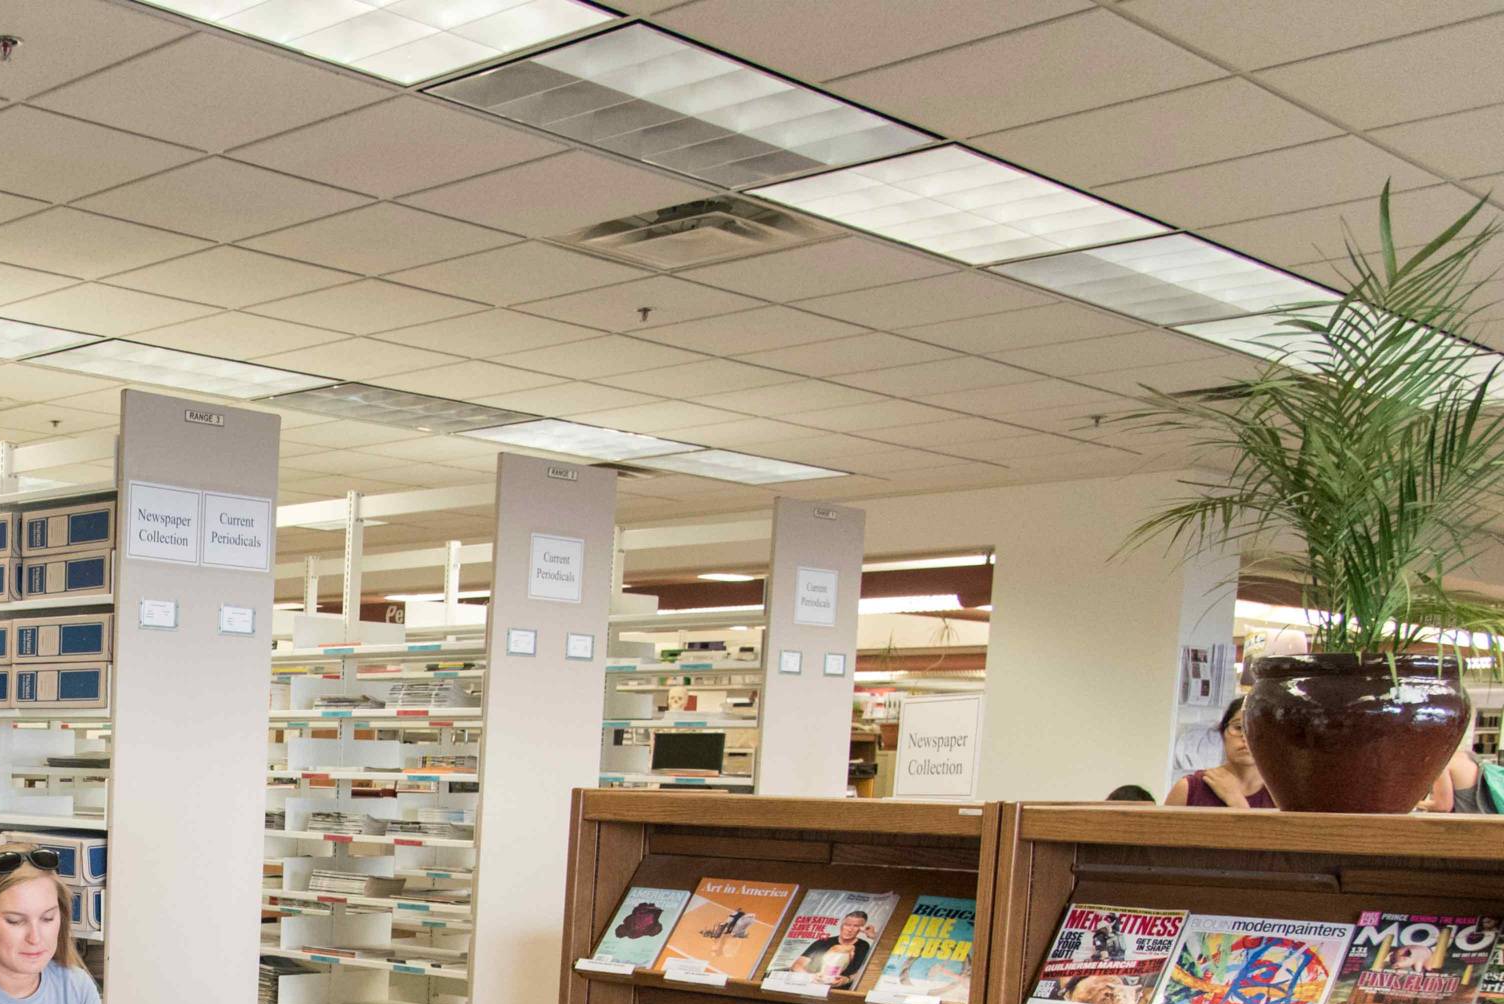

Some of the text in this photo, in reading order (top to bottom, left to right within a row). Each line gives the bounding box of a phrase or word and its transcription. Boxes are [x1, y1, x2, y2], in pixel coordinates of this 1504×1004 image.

[189, 410, 214, 423] RANGE
[137, 508, 192, 528] Newspaper
[219, 512, 255, 528] Current
[138, 528, 189, 547] Collection
[211, 531, 262, 548] Periodicals
[543, 551, 571, 565] Current
[536, 567, 575, 583] Periodicals
[908, 732, 969, 753] Newspaper
[907, 758, 963, 776] Collection
[702, 882, 789, 898] Art in America
[1381, 912, 1409, 922] PRINCE
[1059, 930, 1085, 942] LOSE
[1231, 919, 1347, 938] modernpainters
[1055, 939, 1082, 951] YOUR
[1152, 938, 1174, 947] BACK
